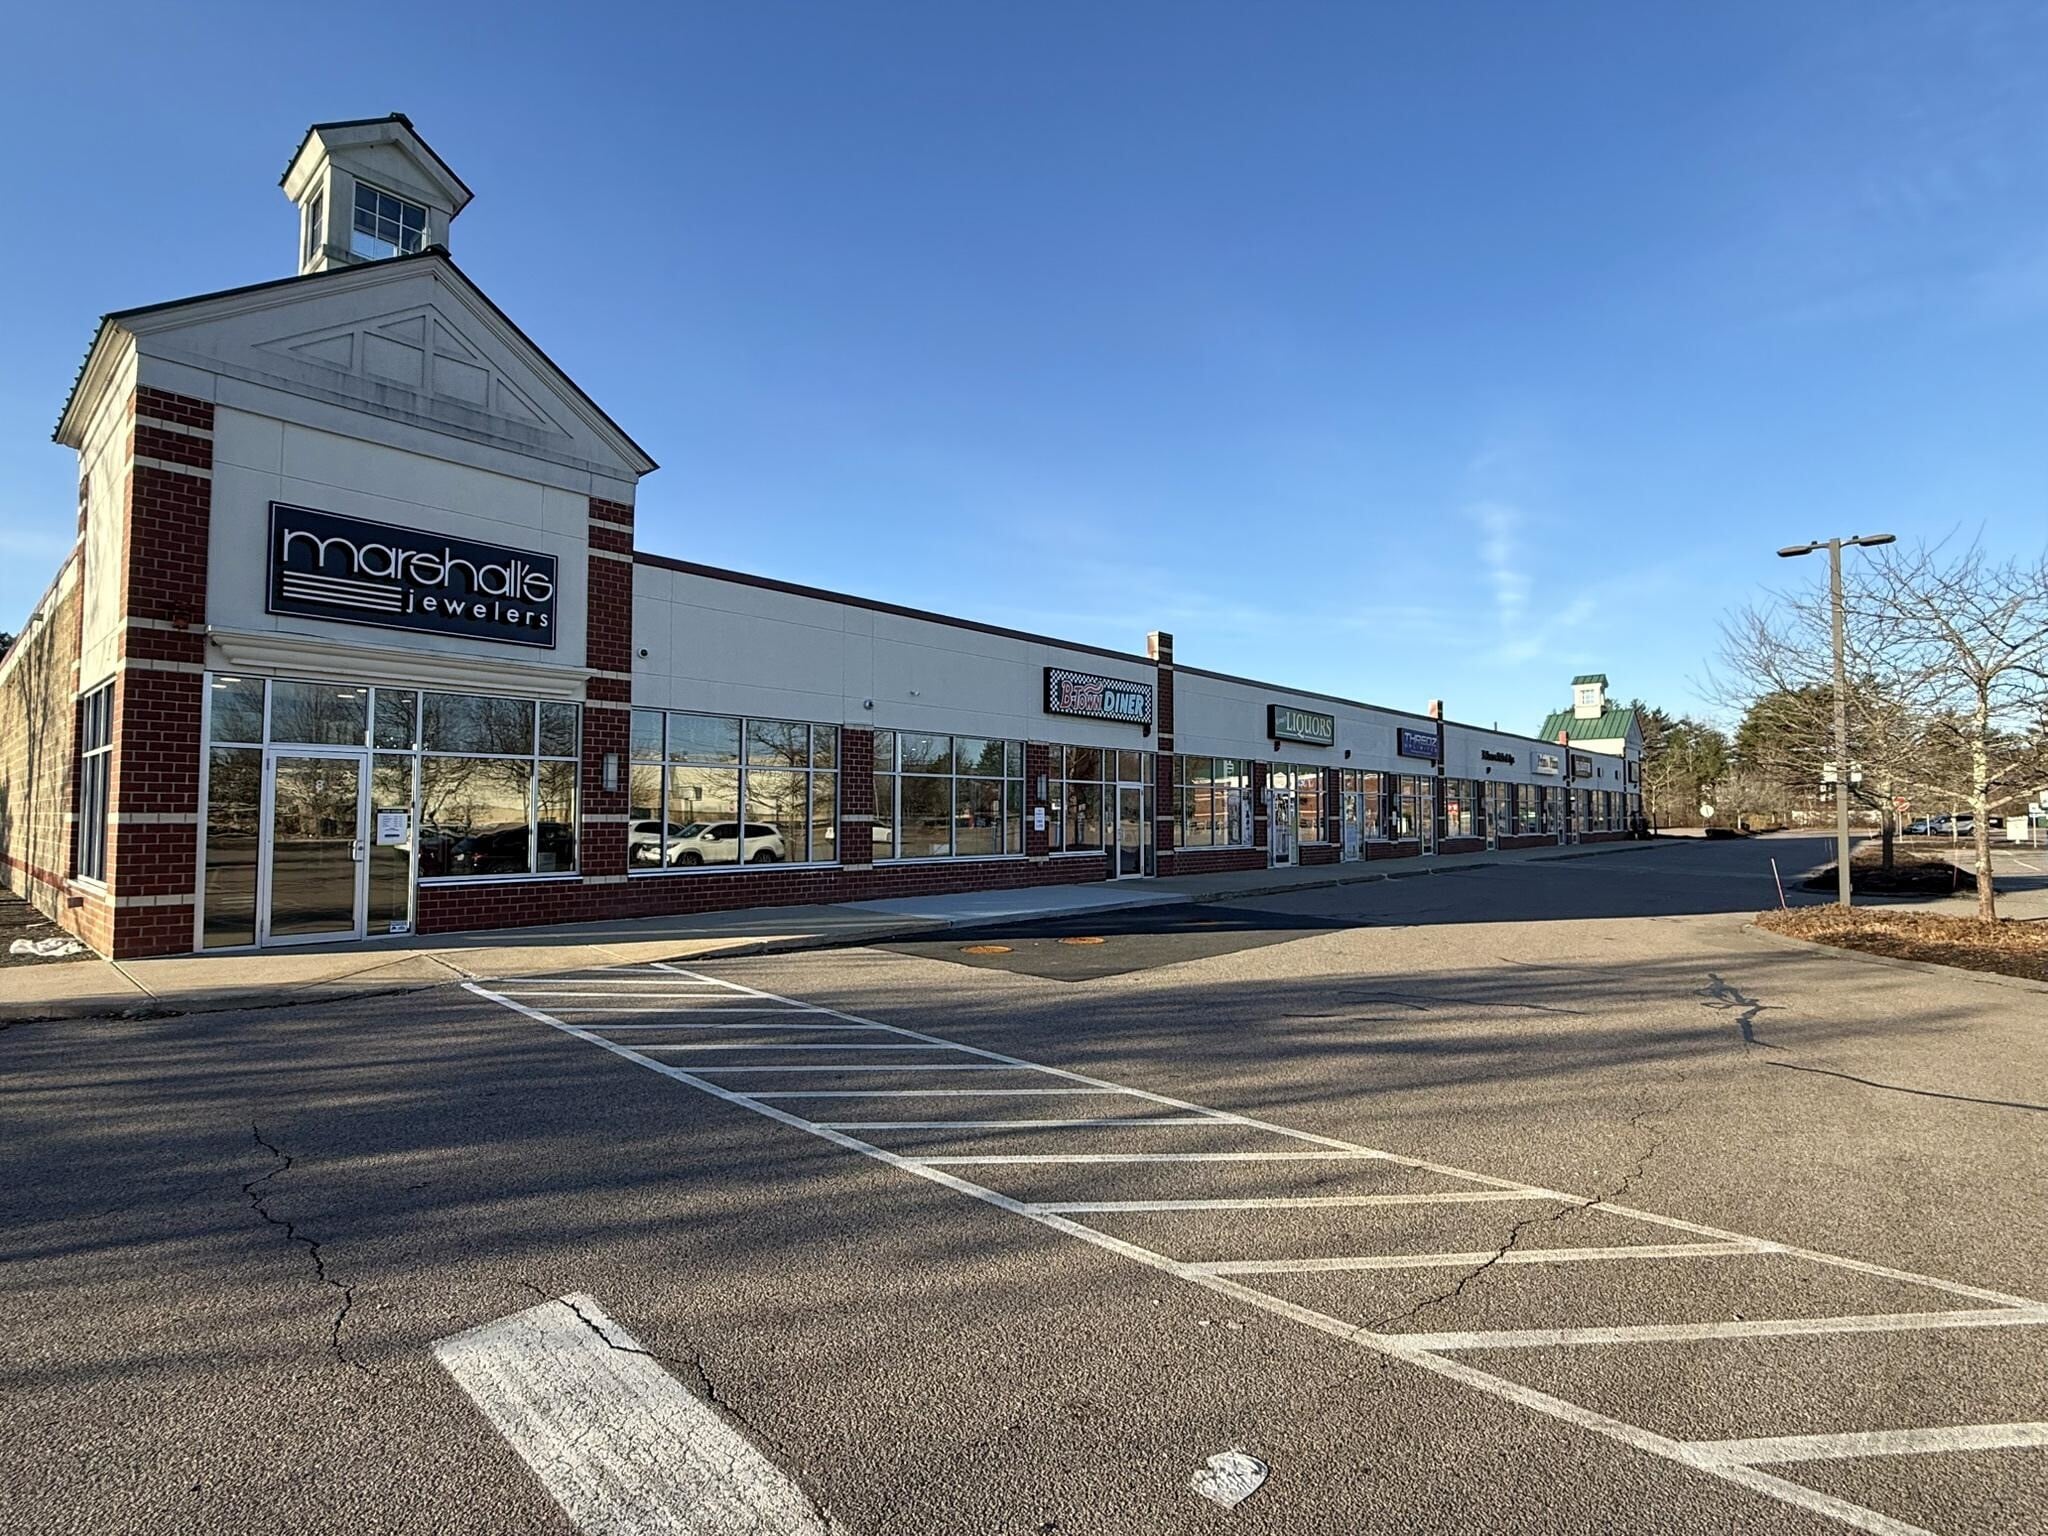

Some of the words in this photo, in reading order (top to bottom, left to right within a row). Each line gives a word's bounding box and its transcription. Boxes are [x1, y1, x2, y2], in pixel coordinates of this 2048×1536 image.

[283, 528, 553, 603] marshall's
[405, 589, 550, 628] jewelers
[1103, 690, 1144, 718] DINER
[1286, 711, 1333, 738] LIQUORS
